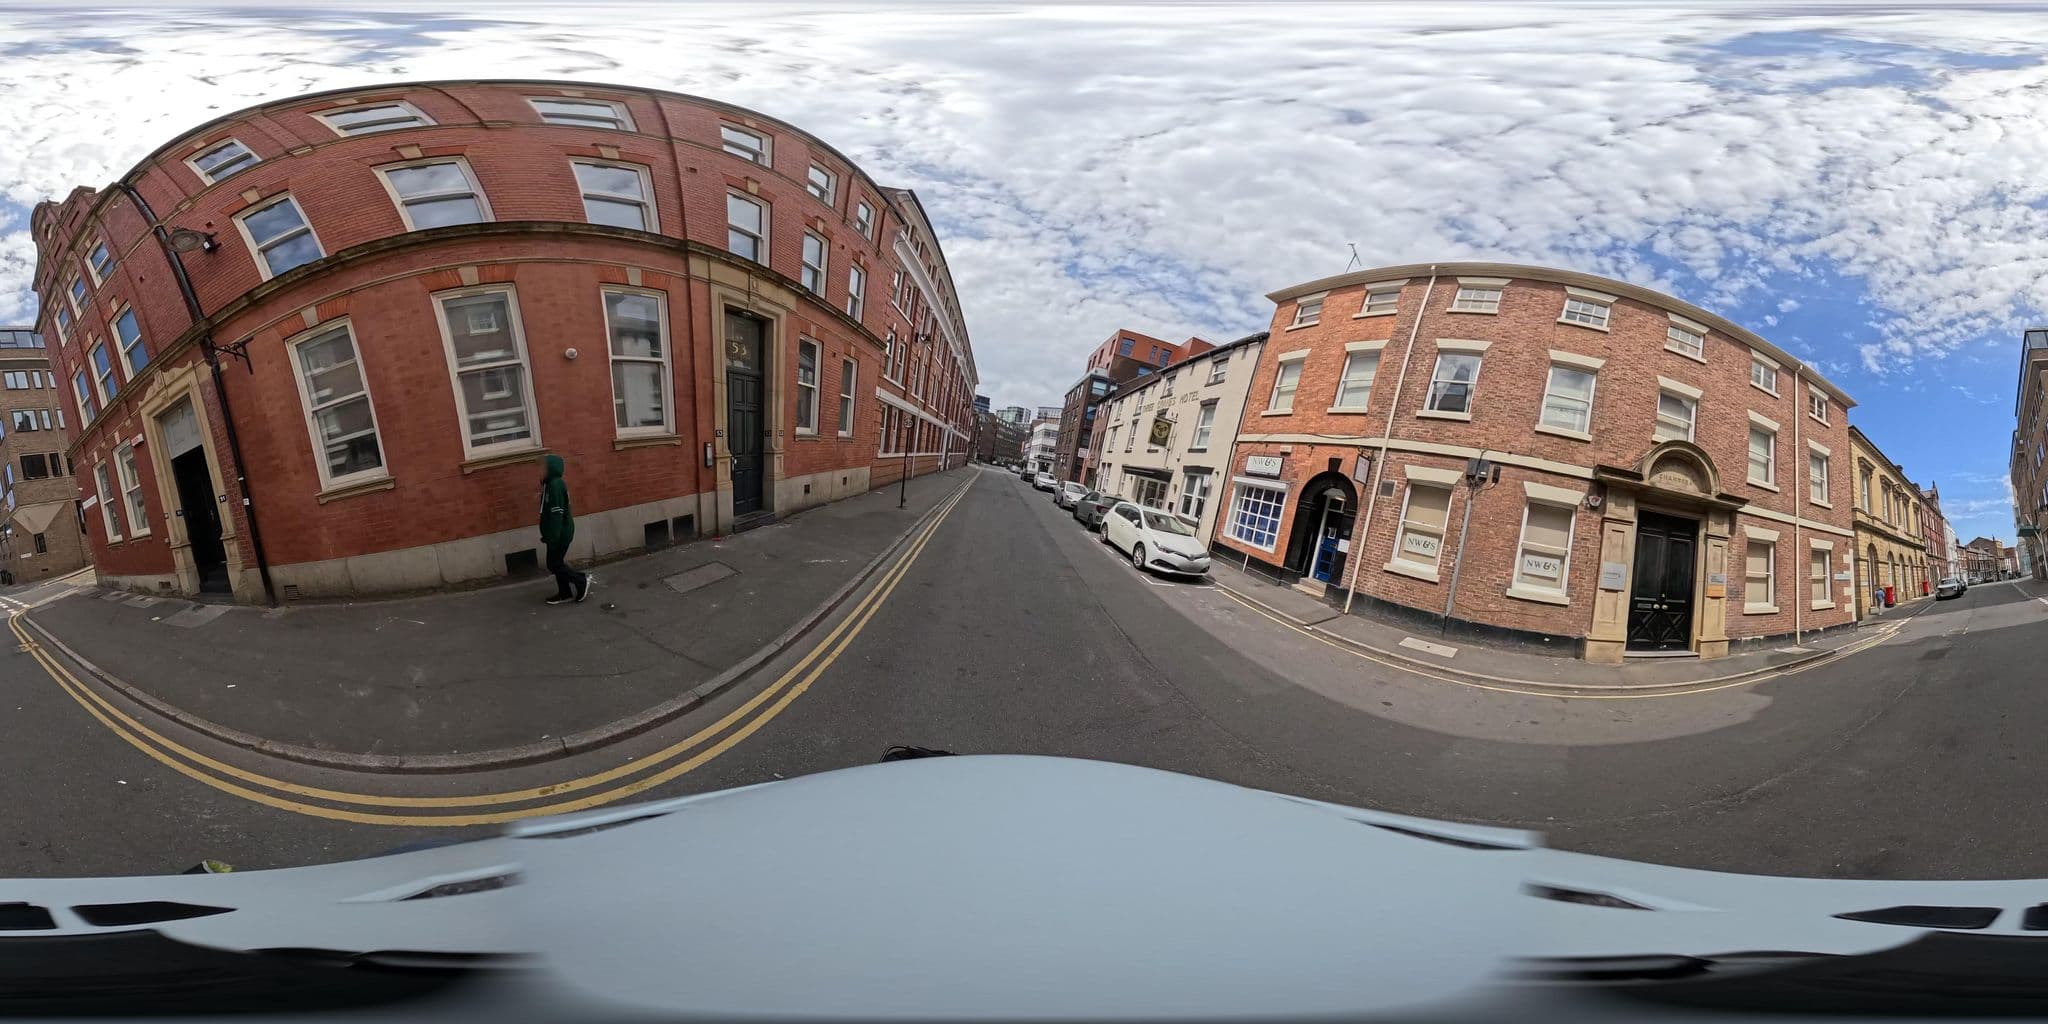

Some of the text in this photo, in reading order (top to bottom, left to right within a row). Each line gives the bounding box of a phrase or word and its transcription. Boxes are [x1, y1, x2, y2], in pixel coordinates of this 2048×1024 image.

[732, 341, 747, 356] 53
[1180, 390, 1200, 404] HOTEL
[1252, 457, 1277, 467] NW&S
[1408, 537, 1436, 550] NW&S
[1527, 559, 1557, 571] NW&S
